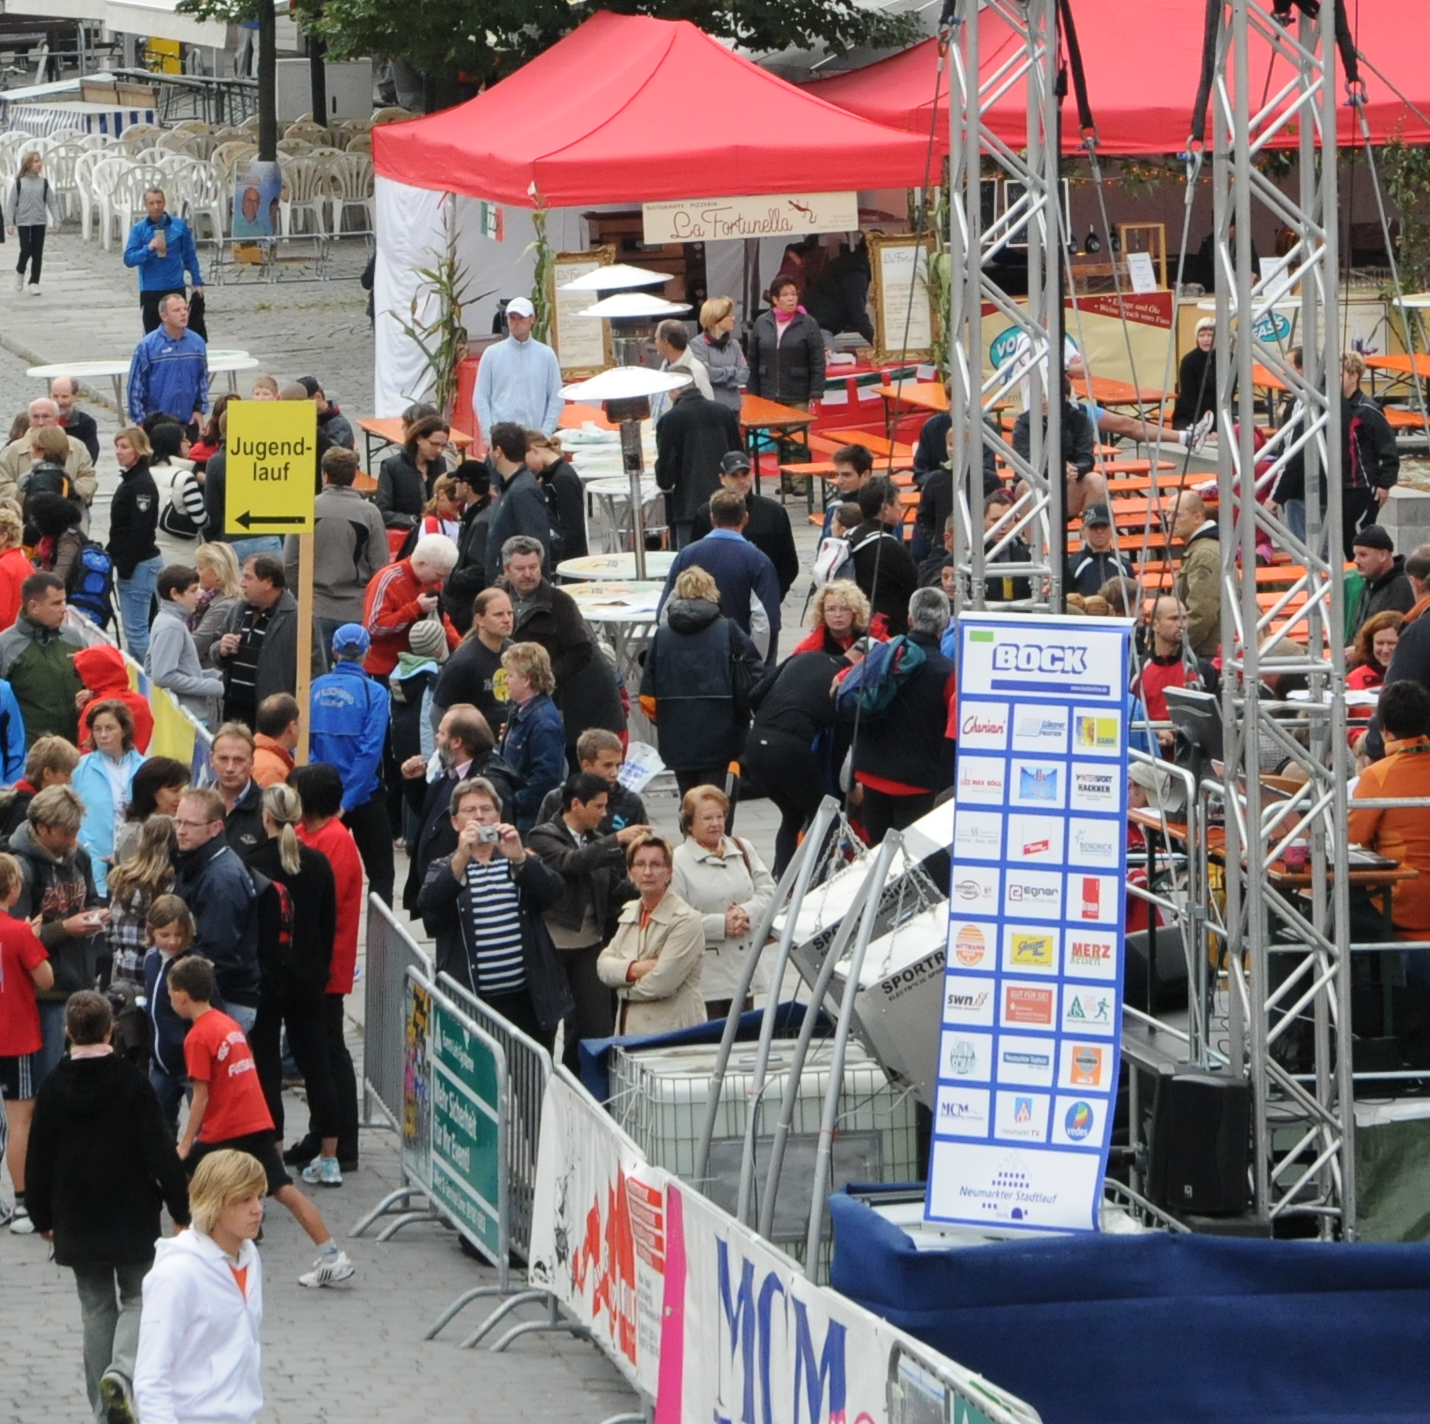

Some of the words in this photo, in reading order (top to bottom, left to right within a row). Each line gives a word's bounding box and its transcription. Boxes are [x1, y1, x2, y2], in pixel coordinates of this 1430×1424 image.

[670, 211, 705, 239] La
[701, 206, 793, 237] Fortunella
[229, 435, 313, 463] Jugend-
[251, 460, 290, 484] lauf
[992, 643, 1088, 675] BOCK
[1024, 885, 1059, 897] Egner
[1072, 942, 1111, 959] MERZ
[881, 950, 946, 996] SPORTR
[948, 994, 973, 1006] swn
[941, 1102, 969, 1115] MCM
[959, 1185, 1013, 1201] Neumarkter
[1015, 1189, 1058, 1205] Stadtlauf
[714, 1233, 848, 1424] MCM
